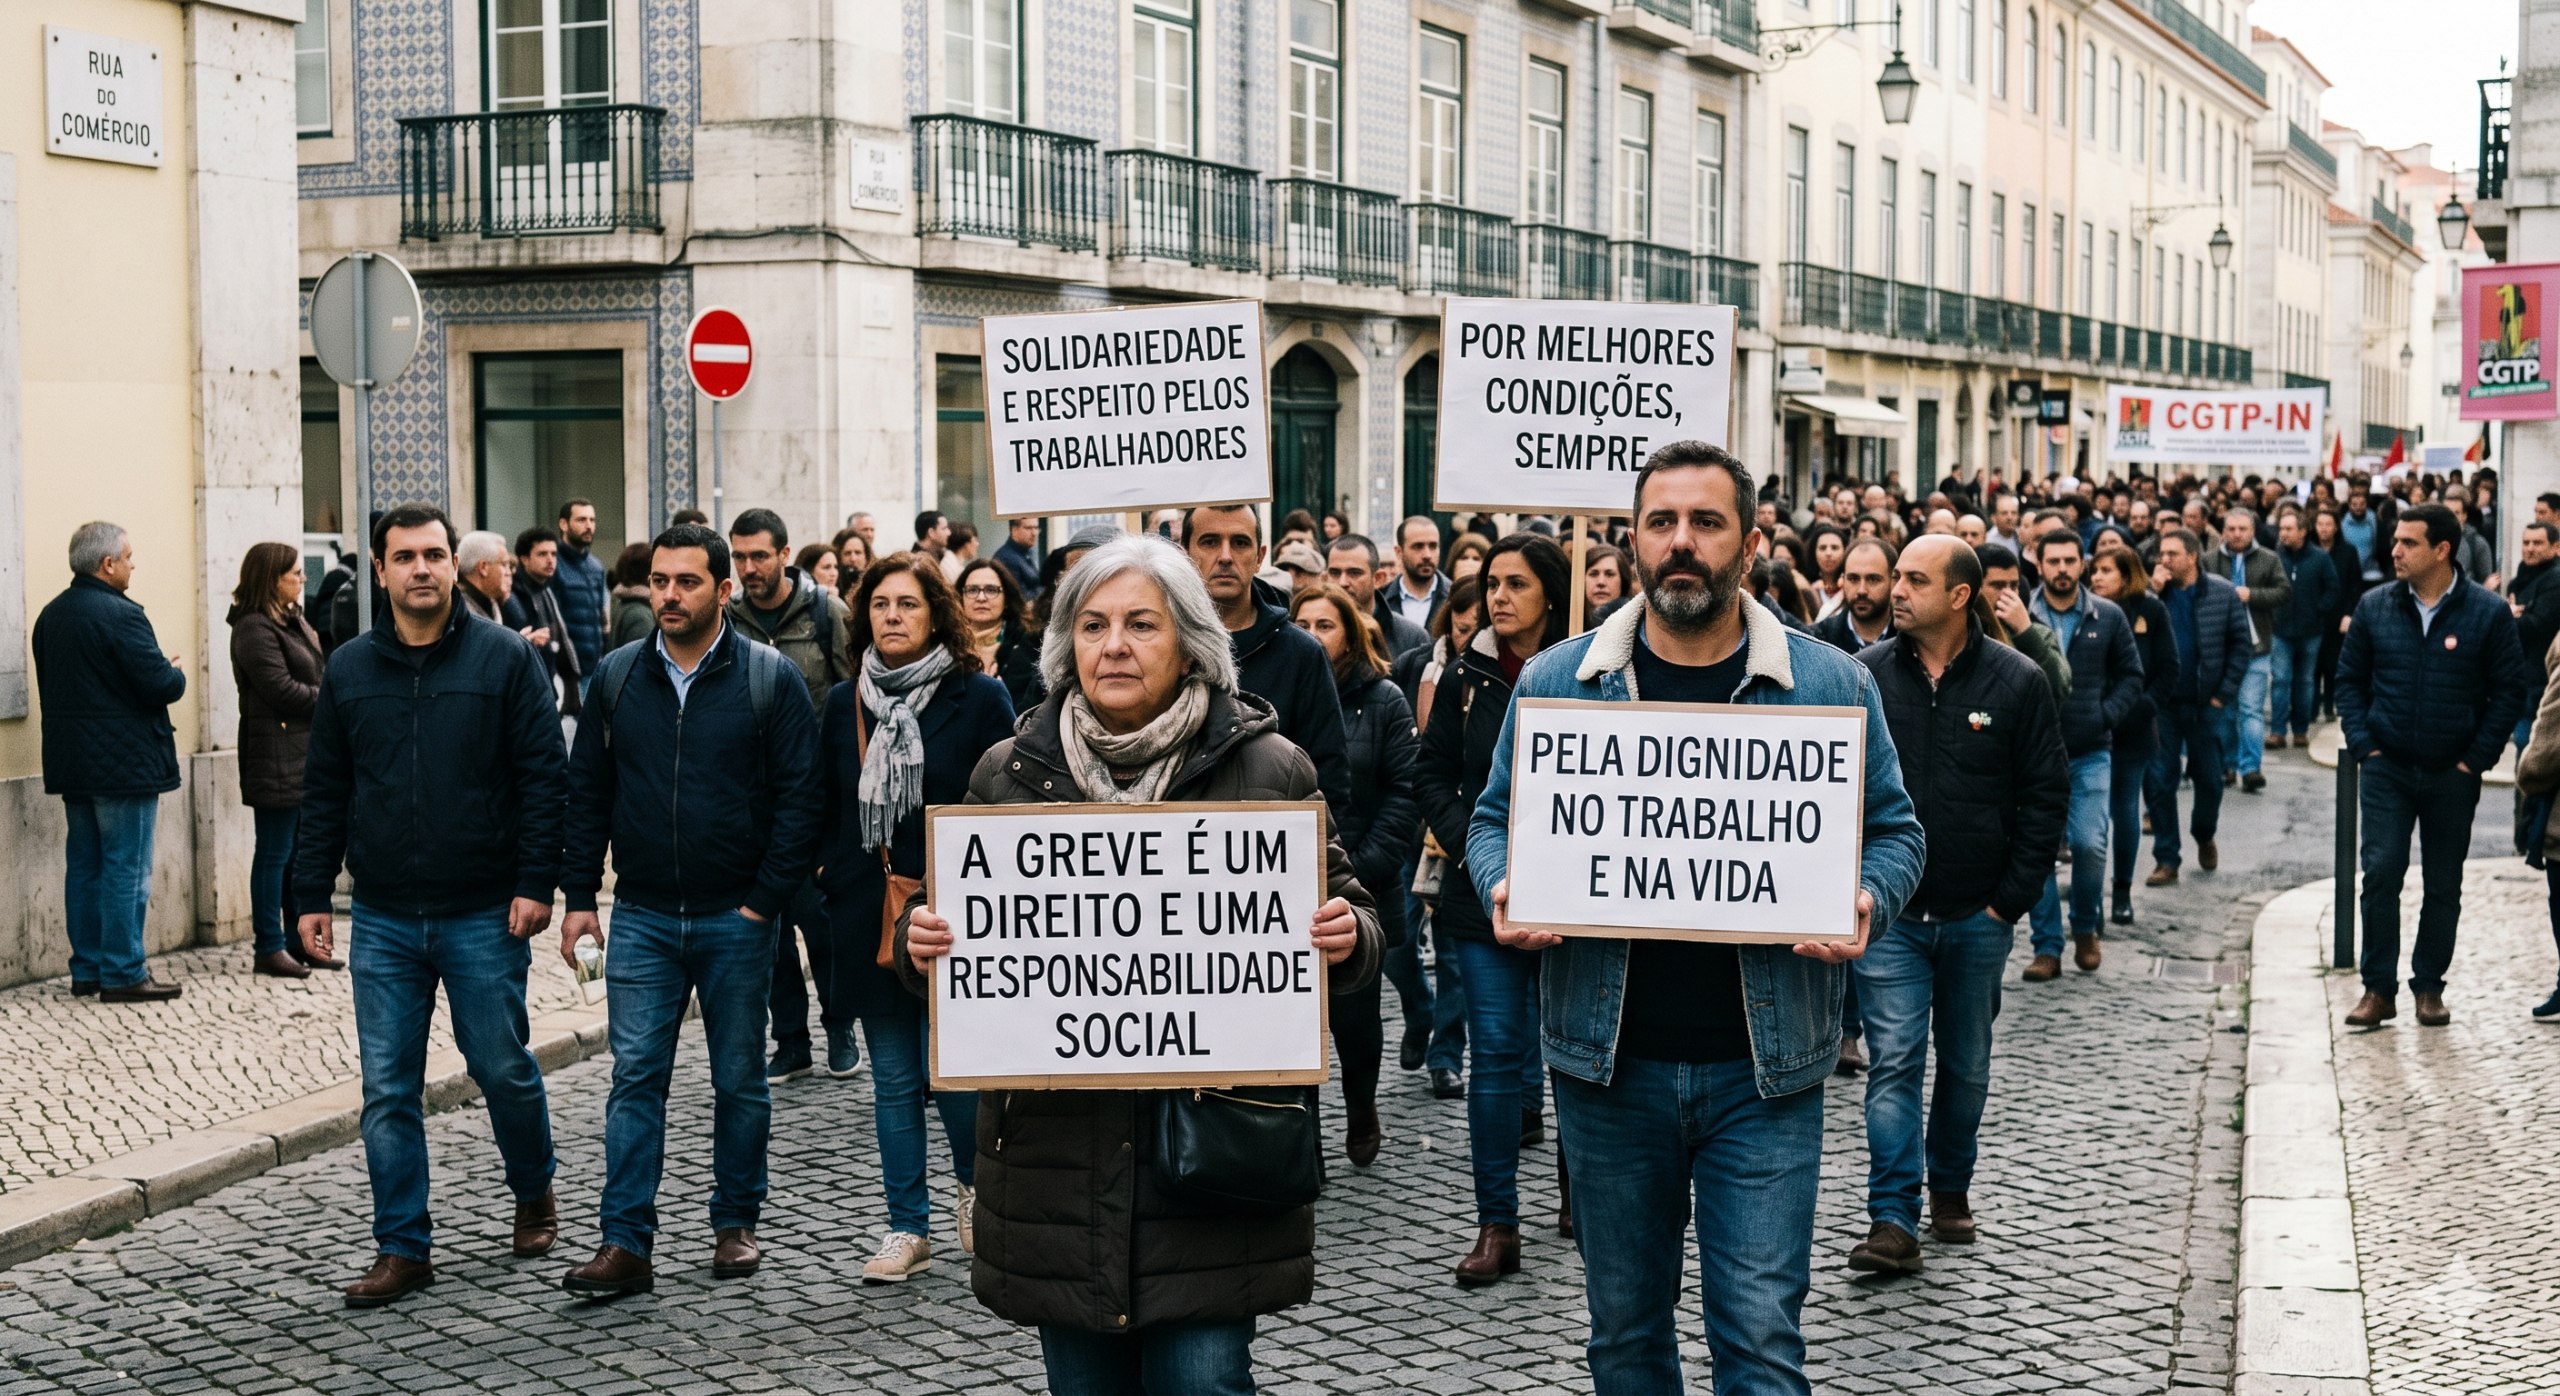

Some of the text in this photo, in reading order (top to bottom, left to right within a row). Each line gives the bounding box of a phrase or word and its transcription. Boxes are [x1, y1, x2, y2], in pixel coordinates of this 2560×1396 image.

[89, 50, 123, 78] RUA
[97, 88, 116, 106] DO
[62, 112, 150, 147] COMÉRCIO
[870, 149, 886, 164] RUA
[1002, 324, 1246, 374] SOLIDARIEDADE
[1460, 322, 1715, 367] POR MELHORES
[2478, 359, 2540, 383] CGTP
[1003, 376, 1250, 423] E RESPEITO PELOS
[1486, 373, 1682, 427] CONDIÇÕES,
[2167, 402, 2311, 431] CGTP-IN
[1009, 425, 1247, 473] TRABALHADORES
[1515, 431, 1649, 472] SEMPRE
[1531, 732, 1848, 783] PELA DIGNIDADE
[1551, 793, 1821, 844] NO TRABALHO
[960, 818, 1287, 879] A GREVE É UM
[1589, 854, 1778, 904] E NA VIDA
[965, 890, 1290, 940] DIREITO E UMA
[949, 950, 1312, 1000] RESPONSABILIDADE
[1055, 1011, 1211, 1059] SOCIAL
